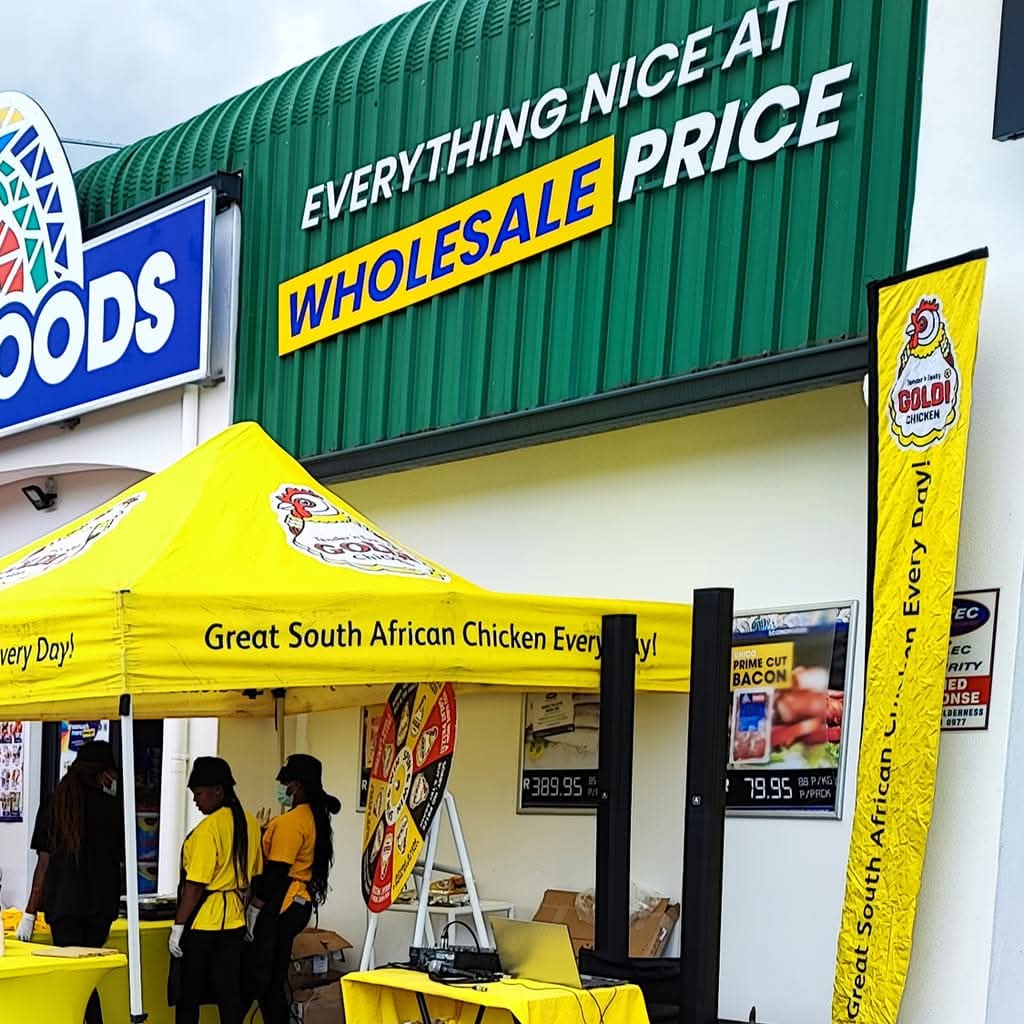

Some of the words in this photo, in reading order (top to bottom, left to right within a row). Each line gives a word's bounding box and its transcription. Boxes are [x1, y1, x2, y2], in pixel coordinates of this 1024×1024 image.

[300, 88, 567, 230] EVERYTHING
[580, 25, 713, 124] NICE
[720, 0, 796, 69] AT
[289, 158, 601, 338] WHOLESALE
[618, 62, 854, 203] PRICE
[898, 380, 951, 413] GOLDI
[906, 409, 940, 425] CHICKEN
[912, 460, 931, 527] Day!
[903, 539, 927, 617] Every
[954, 606, 979, 619] EC
[204, 623, 279, 650] Great
[288, 622, 362, 647] South
[370, 619, 455, 647] African
[462, 620, 546, 650] Chicken
[553, 626, 602, 660] Every
[37, 632, 74, 668] Day!
[950, 645, 971, 655] EC
[733, 658, 763, 670] PRIME
[766, 656, 787, 667] CUT
[947, 661, 982, 672] RITY
[732, 670, 787, 687] BACON
[945, 678, 967, 690] ED
[943, 692, 980, 705] ONSE
[943, 709, 984, 717] LDERNESS
[361, 779, 367, 790] R
[523, 778, 530, 789] R
[531, 777, 582, 796] 389.95
[744, 777, 793, 799] 79.95
[871, 748, 892, 847] African
[857, 857, 881, 936] South
[847, 946, 869, 1019] Great
